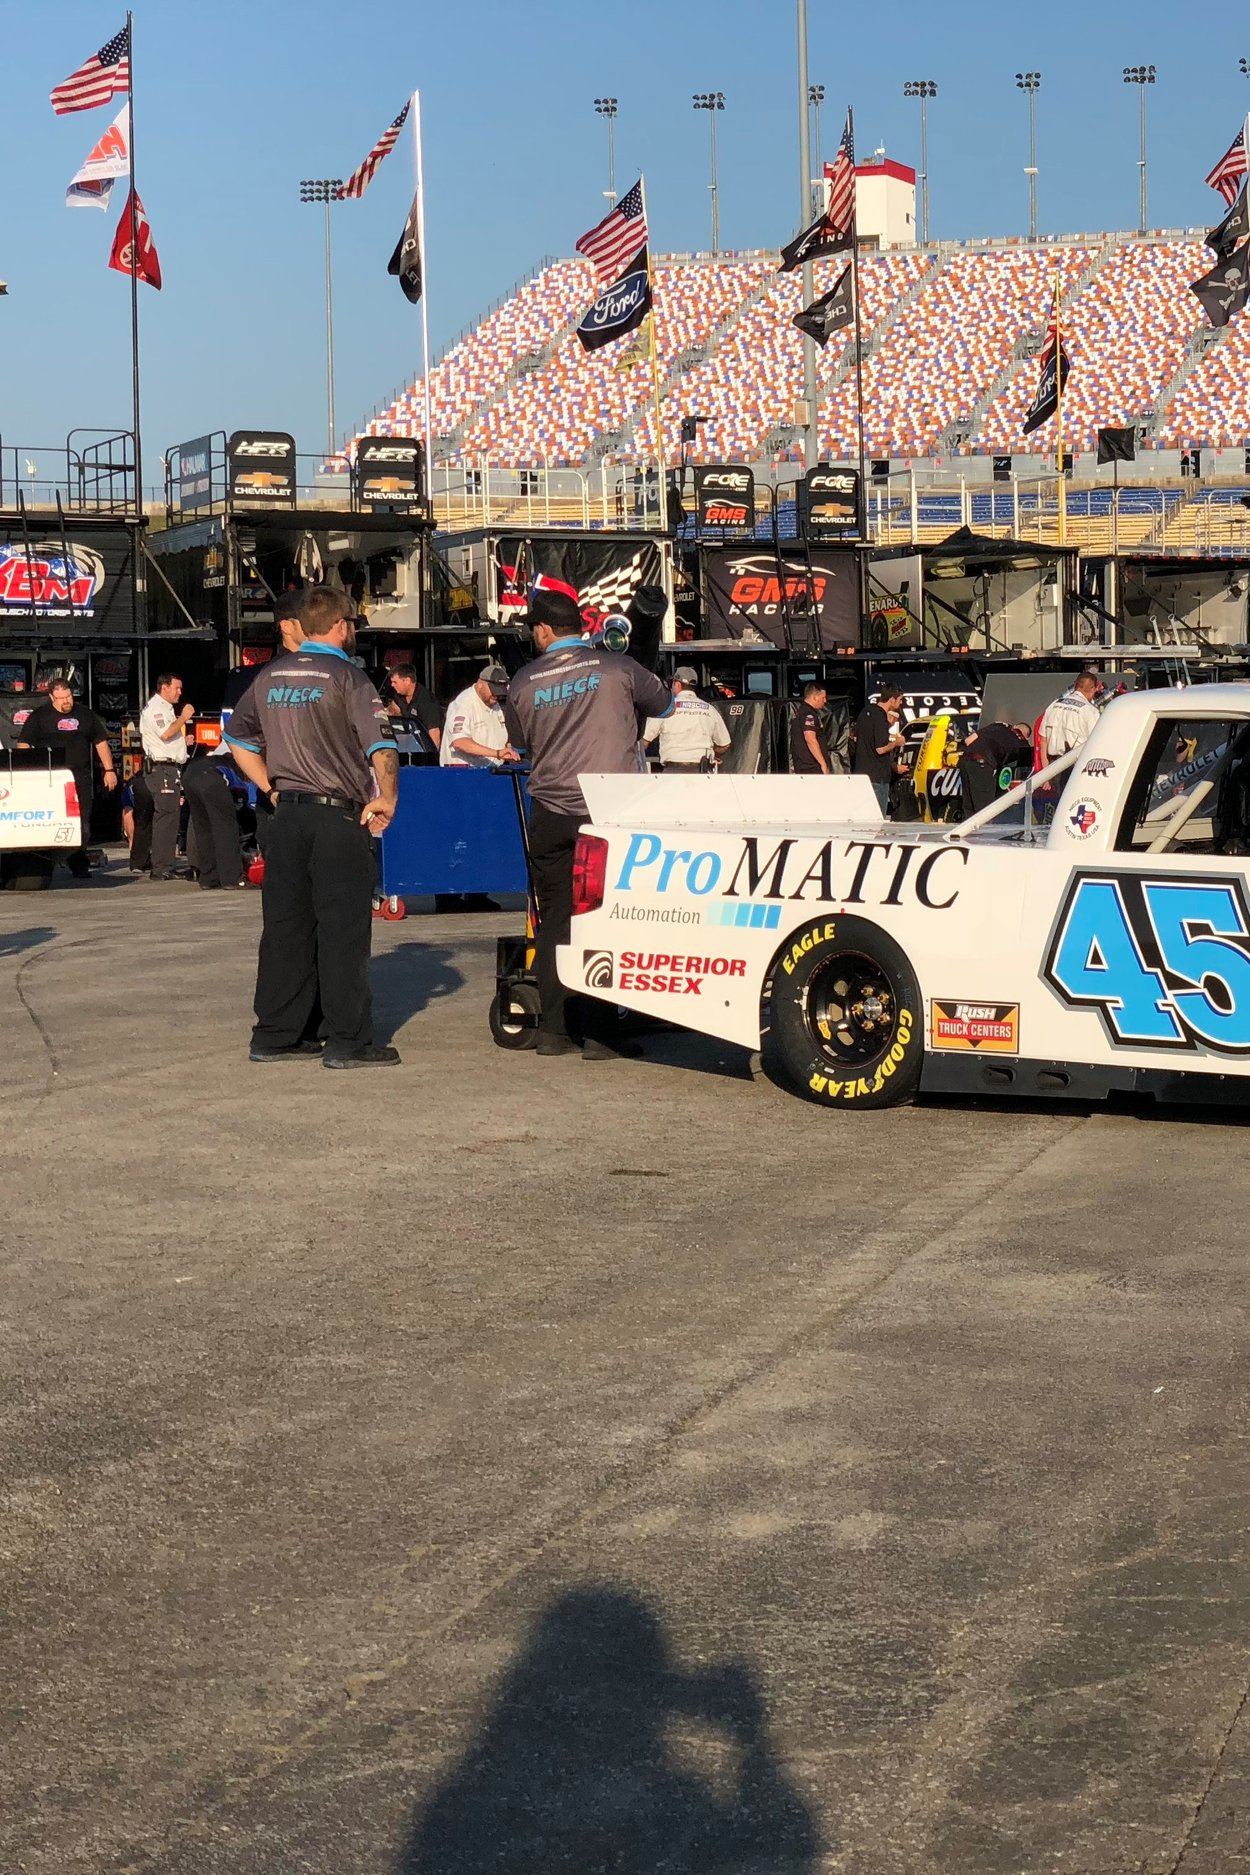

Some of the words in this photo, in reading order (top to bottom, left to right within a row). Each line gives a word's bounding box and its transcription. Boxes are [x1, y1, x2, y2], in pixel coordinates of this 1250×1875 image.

[818, 232, 844, 244] ING
[593, 279, 642, 325] Ford
[234, 486, 292, 497] CHEVROLET
[363, 492, 419, 501] CHEVROLET
[704, 518, 746, 526] RACING
[705, 507, 747, 520] GMS
[810, 516, 857, 525] CHEVROLET
[202, 575, 227, 589] CHEVROLET
[730, 577, 828, 604] GMS
[870, 595, 903, 612] ENARDS
[266, 685, 326, 704] NIECE
[534, 672, 603, 707] NIECE
[869, 695, 984, 707] RECORS
[201, 729, 219, 741] JBL
[54, 826, 75, 843] 51
[608, 902, 702, 926] Automation
[780, 921, 837, 977] EAGLE
[618, 950, 748, 979] SUPERIOR
[618, 971, 705, 997] ESSEX
[938, 1021, 969, 1036] TRUCK
[970, 1022, 1013, 1039] CENTERS
